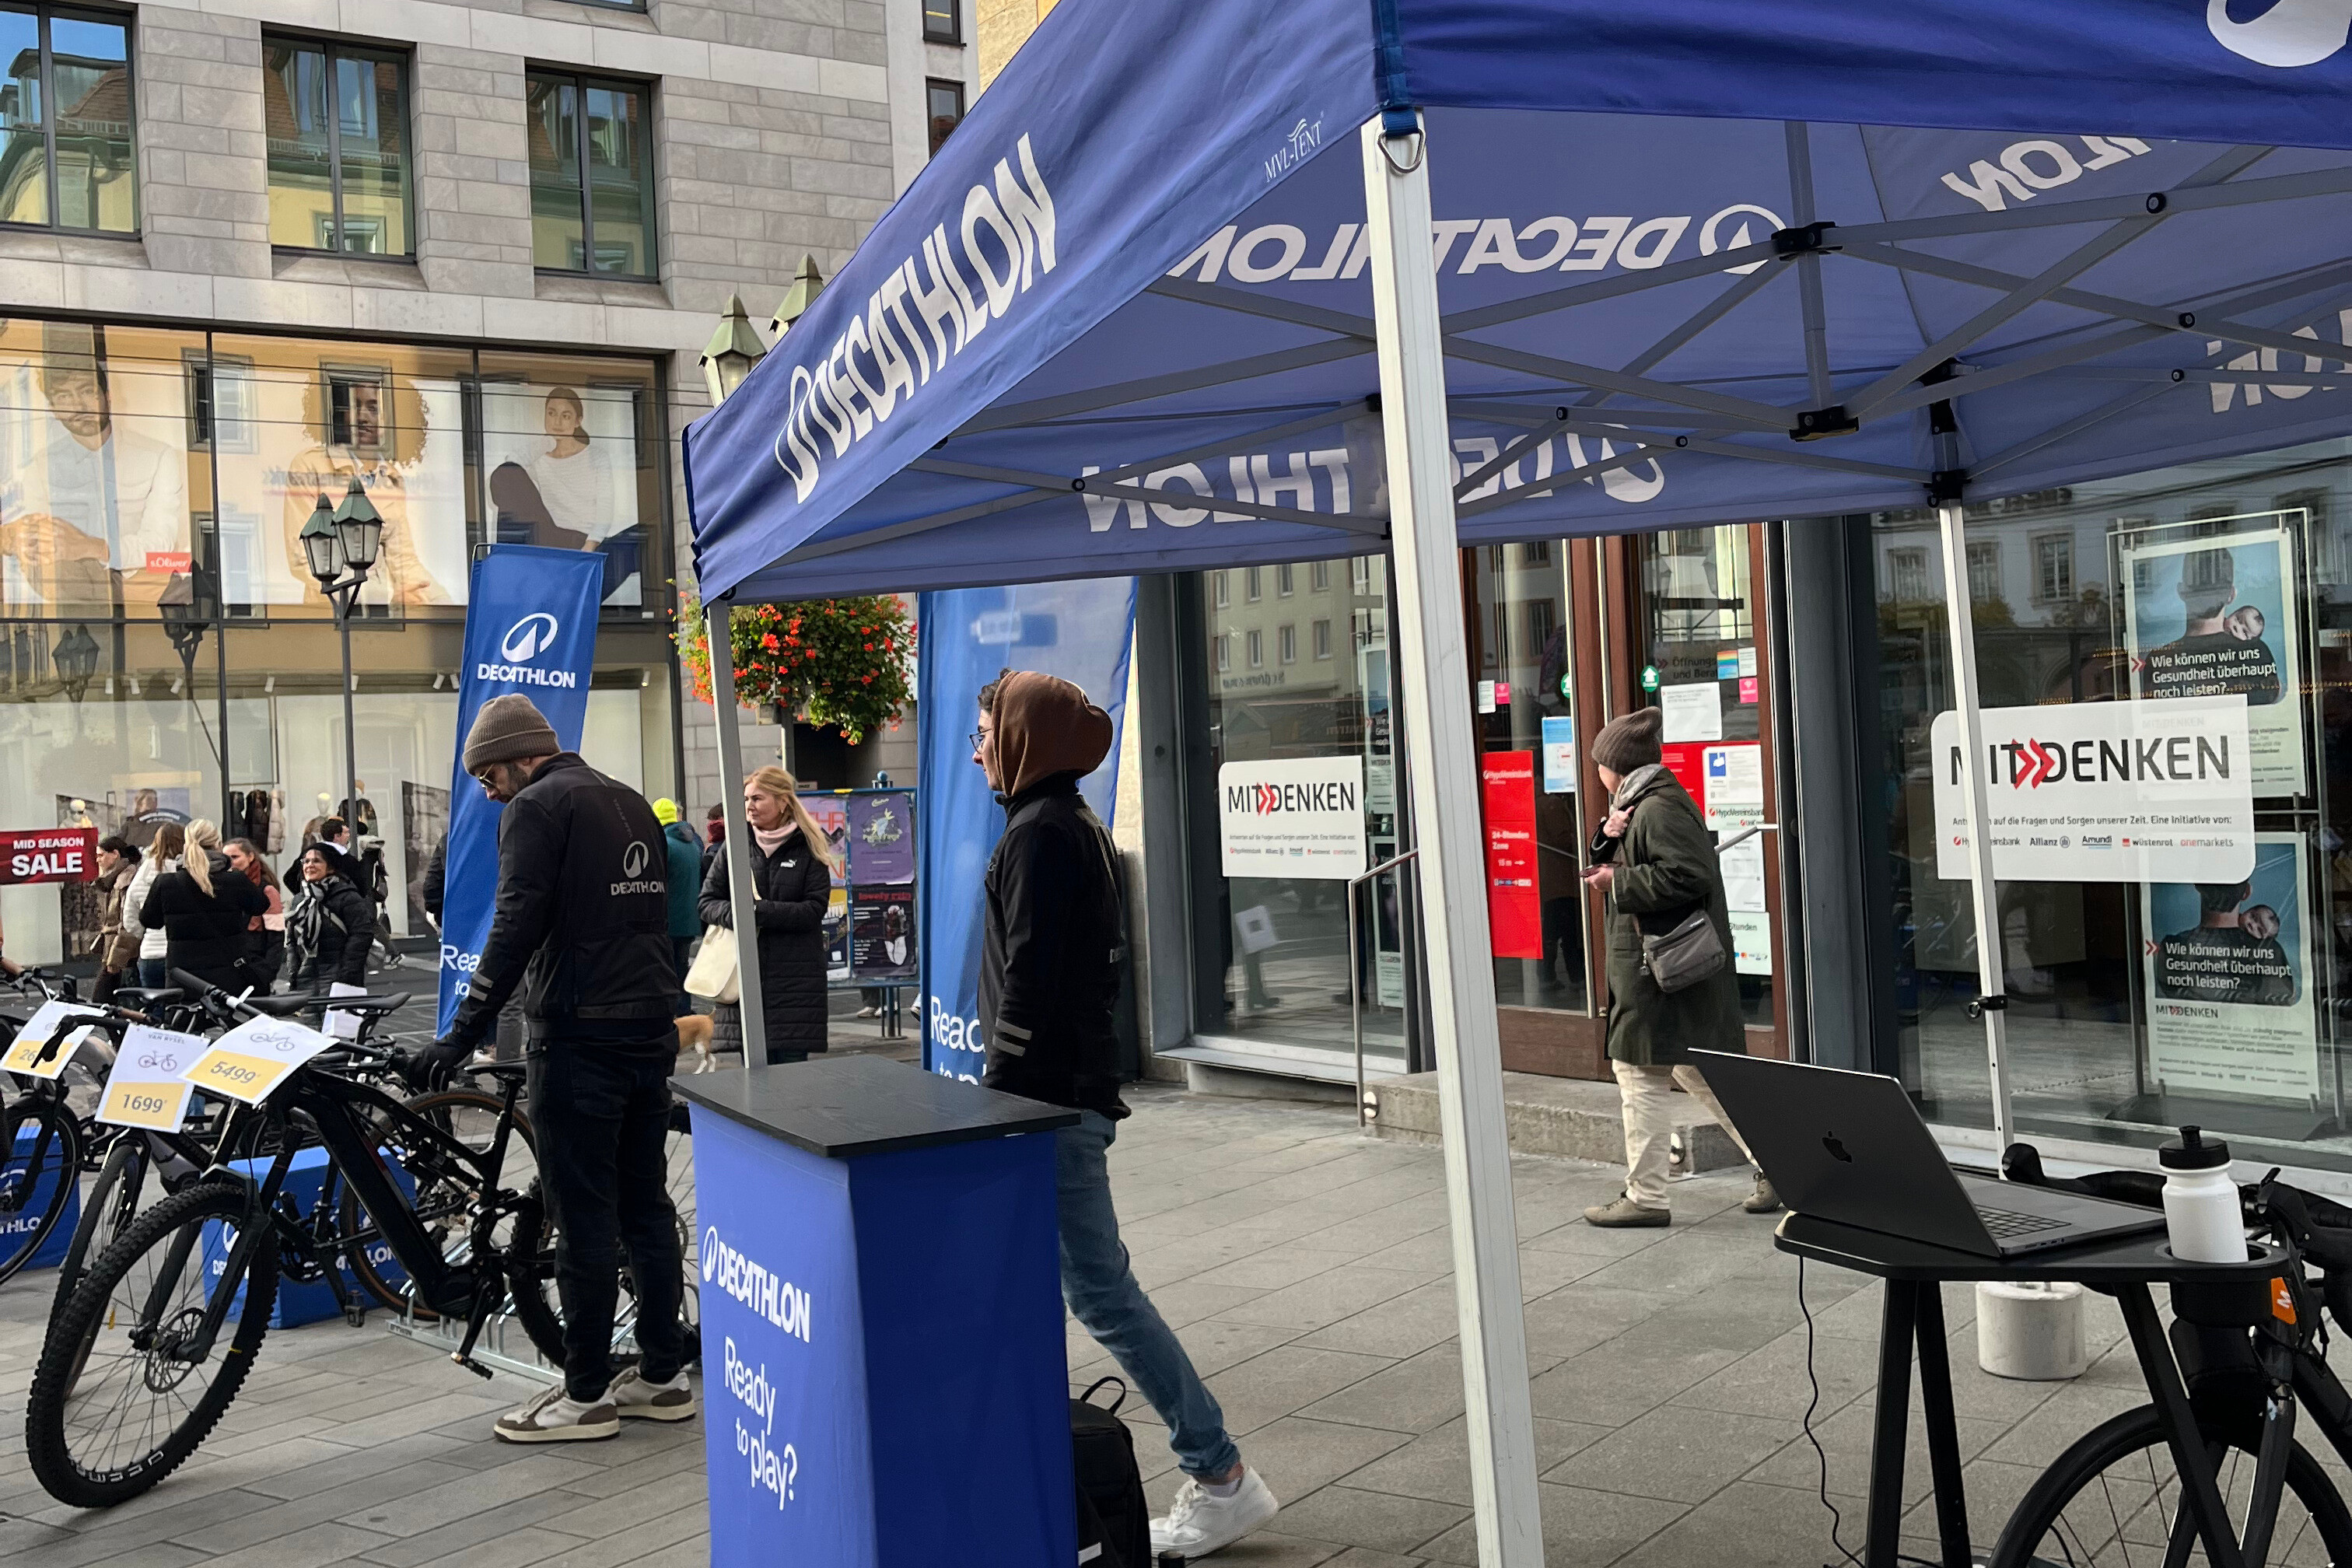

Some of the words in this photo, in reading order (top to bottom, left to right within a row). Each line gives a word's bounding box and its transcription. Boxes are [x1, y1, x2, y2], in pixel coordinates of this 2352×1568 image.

[1265, 118, 1321, 183] MVL-TENT
[810, 132, 1057, 459] DECATHLON
[2151, 655, 2172, 668] Wie
[2175, 652, 2216, 667] können
[2218, 649, 2236, 662] wir
[2238, 648, 2260, 660] uns
[478, 663, 576, 689] DECATHLON
[2152, 667, 2216, 684] Gesundheit
[2217, 661, 2278, 679] überhaupt
[2153, 686, 2181, 698] noch
[2182, 681, 2228, 697] leisten?
[1993, 817, 2006, 825] auf
[2007, 817, 2020, 825] die
[2021, 817, 2048, 827] Fragen
[2049, 816, 2065, 825] und
[2067, 816, 2095, 827] Sorgen
[2130, 815, 2149, 824] Zeit.
[2151, 815, 2169, 824] Eine
[2171, 814, 2210, 824] Initiative
[2213, 816, 2232, 824] von:
[13, 839, 36, 849] MID
[38, 837, 84, 849] SEASON
[2029, 837, 2058, 846] Allianz
[2081, 835, 2112, 843] Amundi
[2132, 838, 2173, 847] wüstenrot
[2180, 837, 2234, 847] onemarkets
[12, 852, 83, 877] SALE
[439, 944, 481, 972] Rea
[2166, 941, 2186, 955] Wie
[2189, 942, 2230, 957] können
[2232, 945, 2249, 957] wir
[2253, 947, 2274, 960] uns
[2165, 957, 2228, 973] Gesundheit
[2231, 961, 2292, 978] überhaupt
[2167, 974, 2194, 987] noch
[2196, 975, 2241, 990] leisten?
[718, 1240, 810, 1343] DECATHLON
[725, 1335, 776, 1437] Ready
[736, 1417, 749, 1457] to
[751, 1429, 798, 1511] play?
